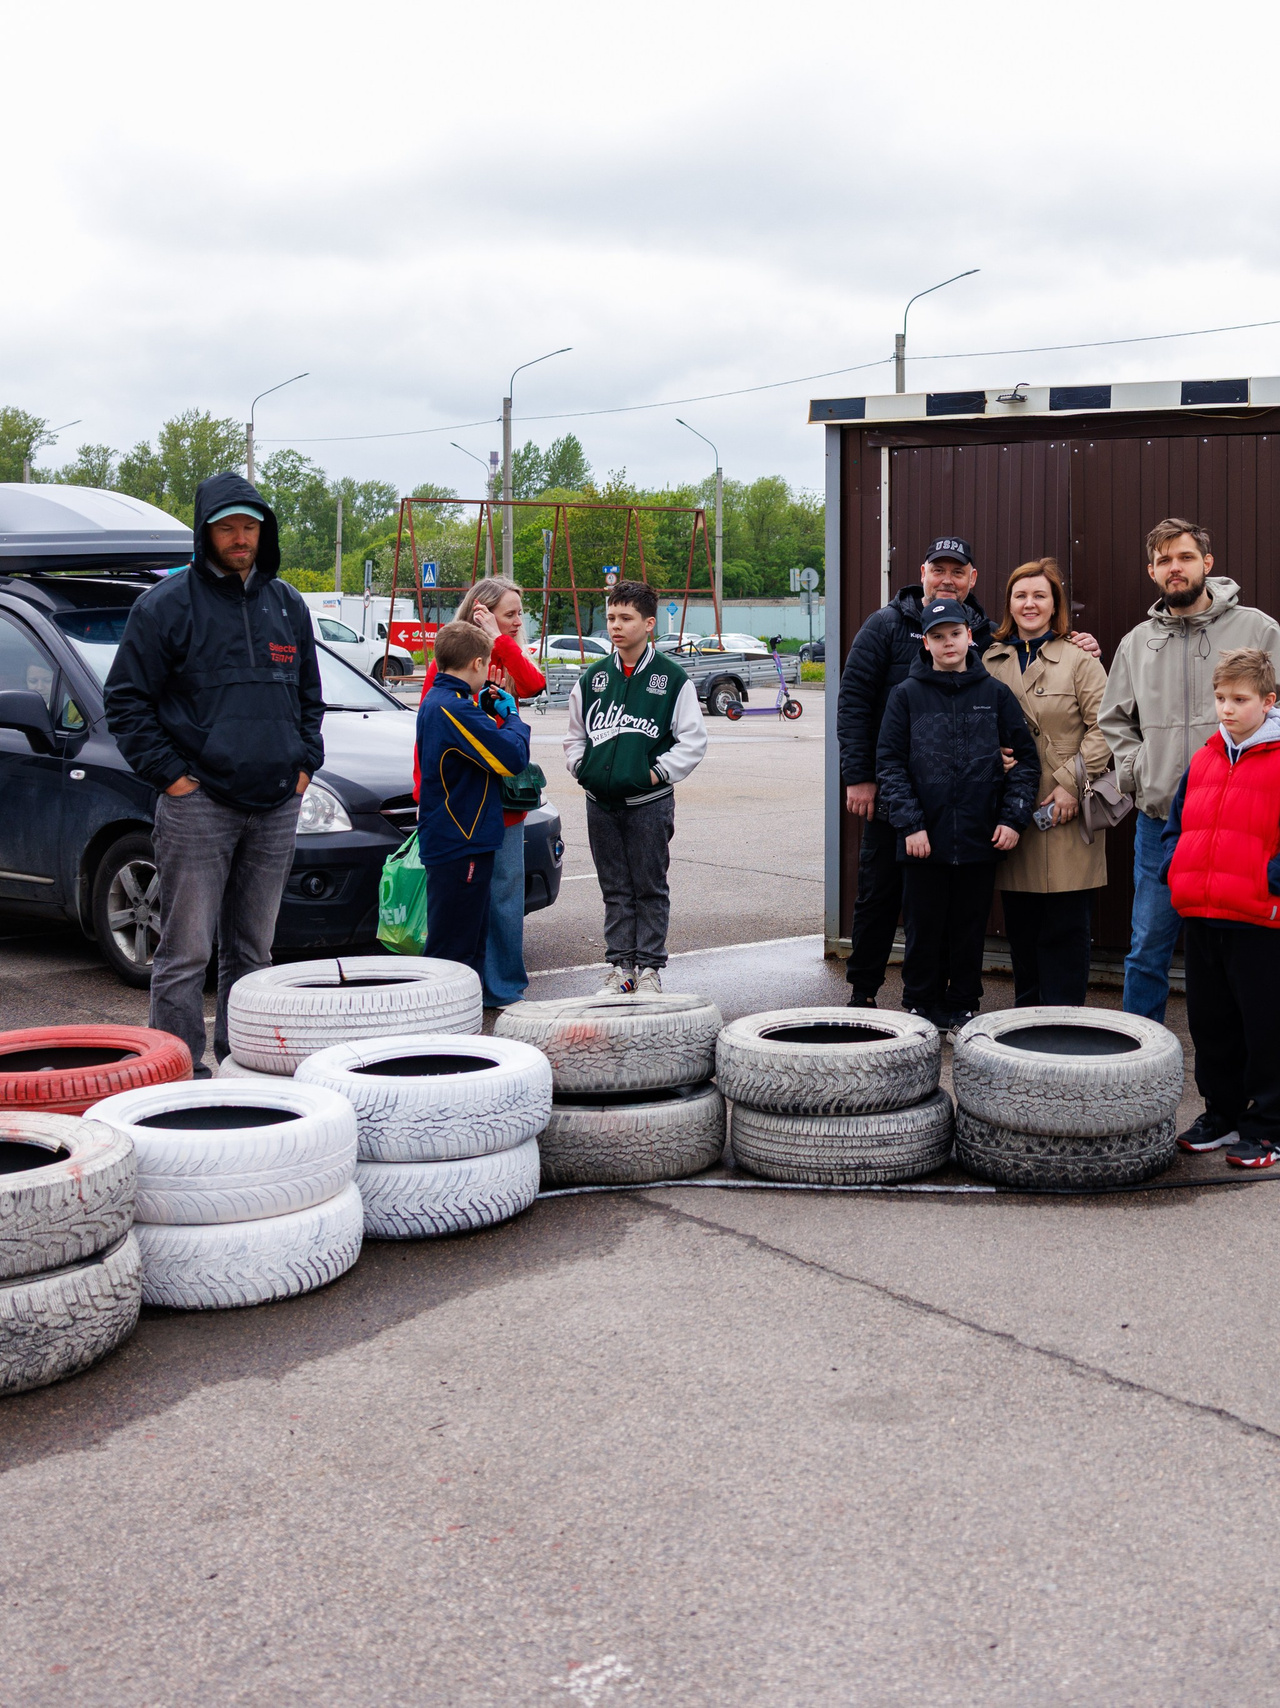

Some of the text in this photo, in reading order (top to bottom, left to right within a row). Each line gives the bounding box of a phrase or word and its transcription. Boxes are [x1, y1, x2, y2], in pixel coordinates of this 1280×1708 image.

[935, 540, 965, 554] USPA
[594, 677, 606, 687] LA
[648, 674, 668, 689] 88
[585, 698, 660, 738] California
